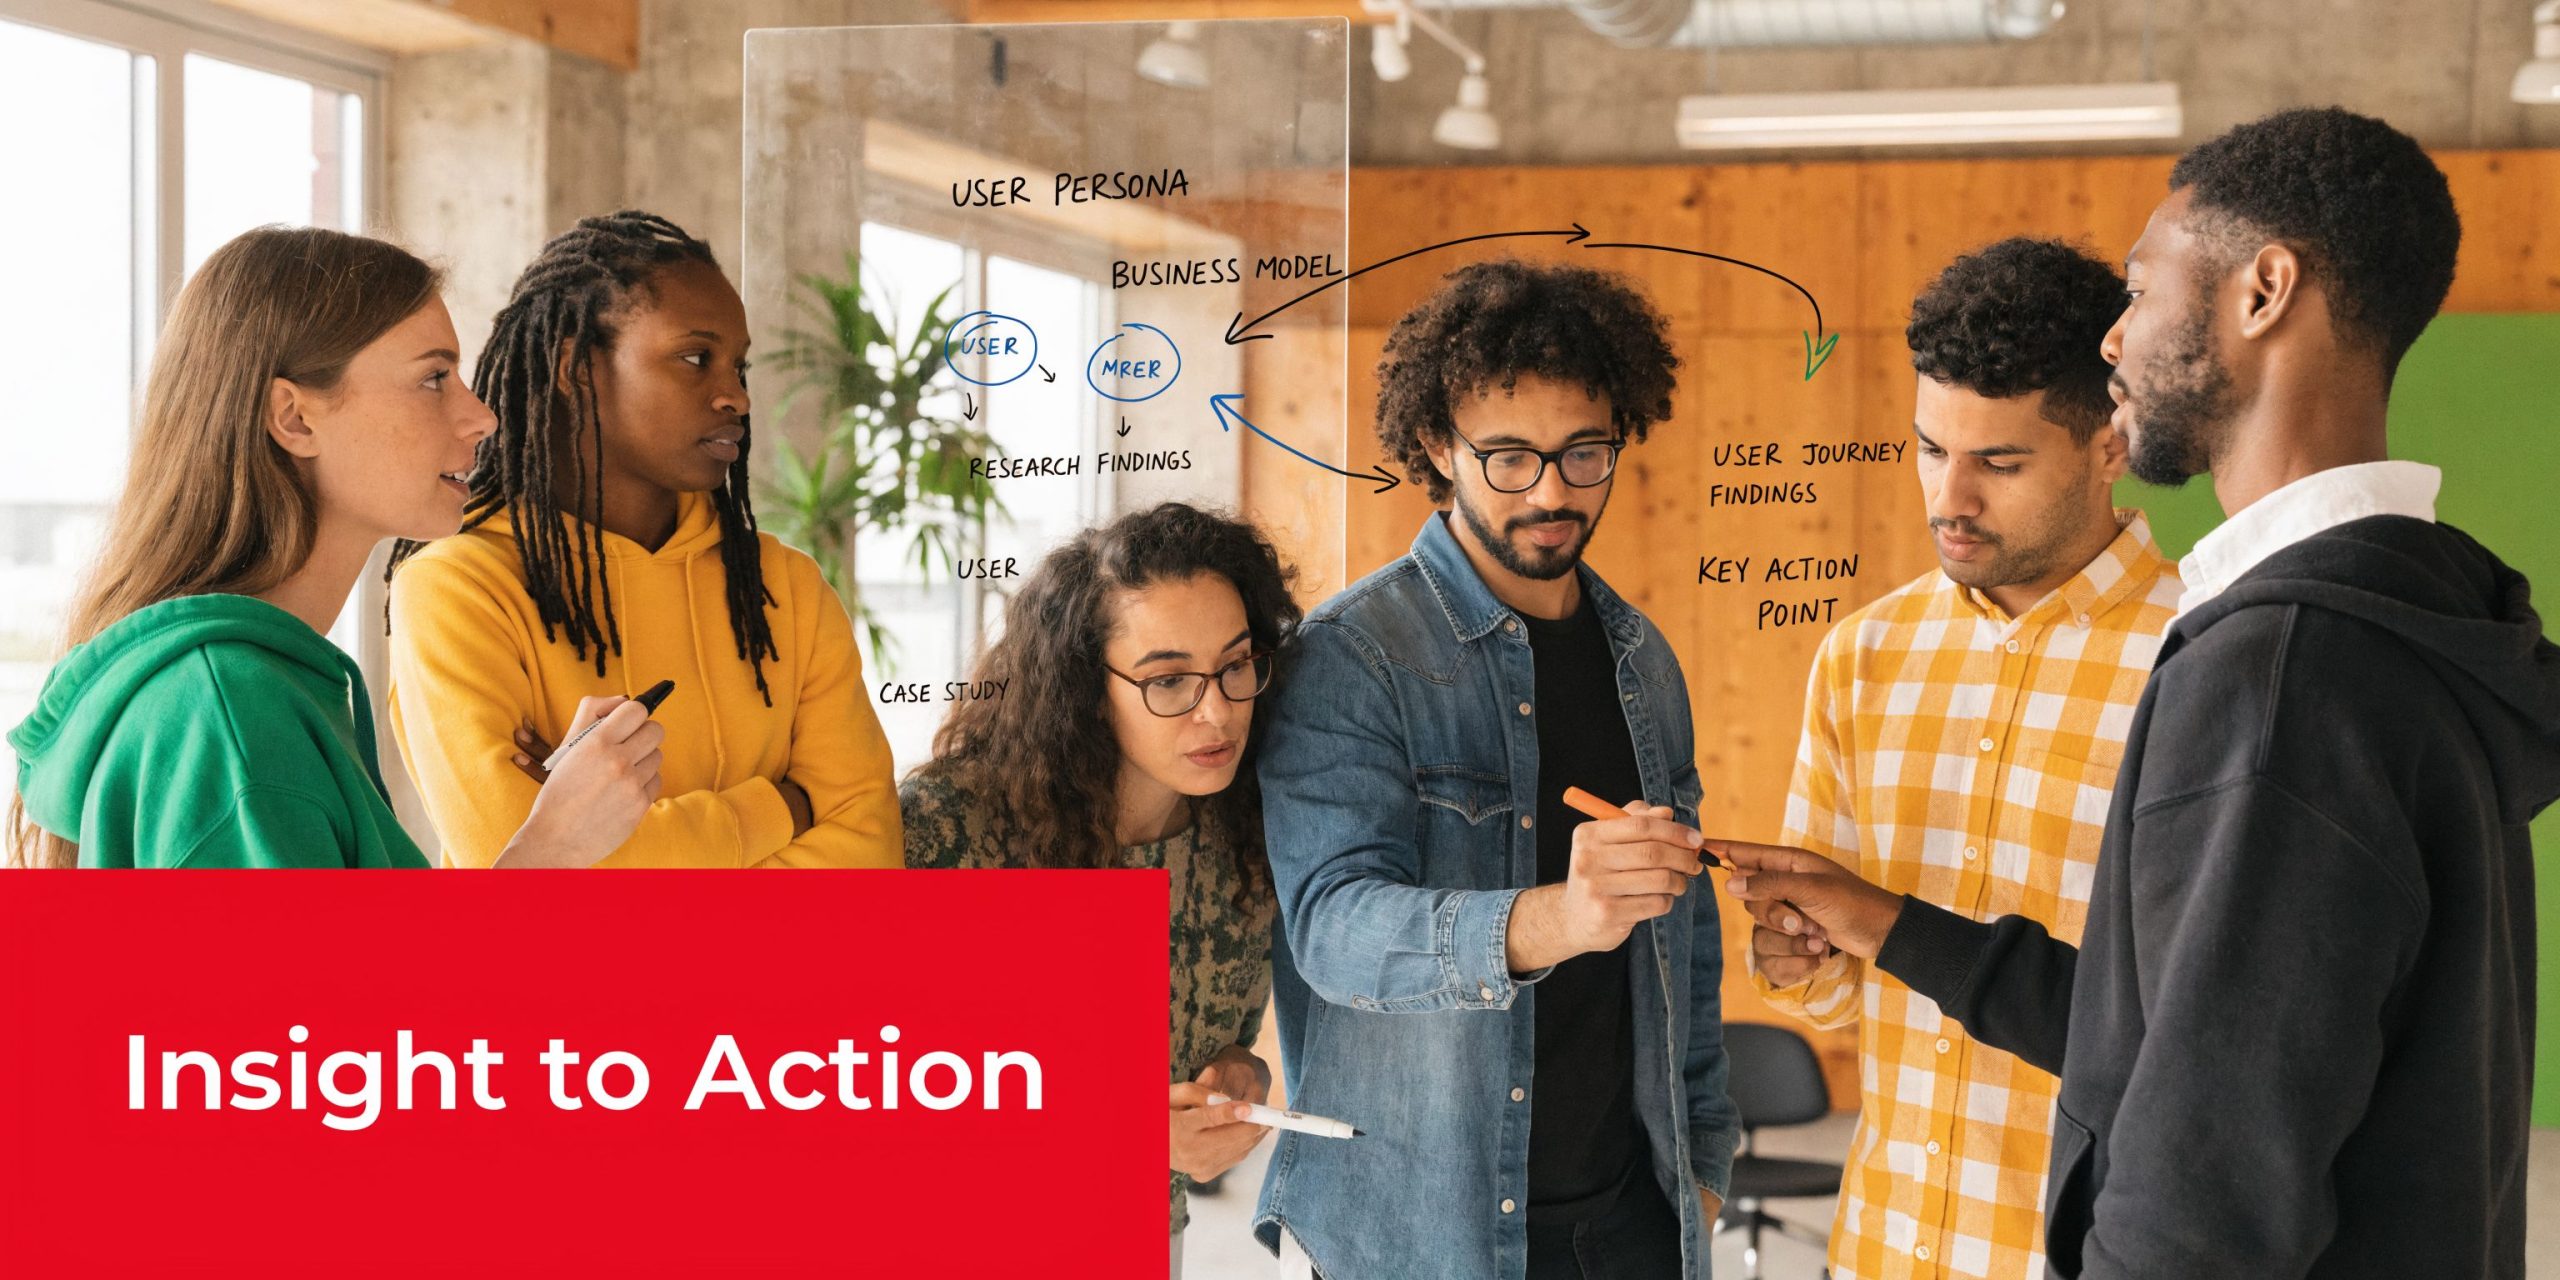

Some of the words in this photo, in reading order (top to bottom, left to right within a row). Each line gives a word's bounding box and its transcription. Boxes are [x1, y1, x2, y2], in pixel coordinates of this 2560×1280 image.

[953, 176, 1030, 207] USER
[1055, 169, 1189, 206] PERSONA
[1112, 258, 1240, 289] BUSINESS
[1256, 254, 1343, 281] MODEL
[961, 337, 1019, 356] USER
[1102, 359, 1162, 379] MRER
[969, 455, 1080, 480] RESEARCH
[1097, 450, 1192, 474] FINDINGS
[1714, 442, 1782, 467] USER
[1802, 440, 1907, 465] JOURNEY
[1711, 482, 1817, 507] FINDINGS
[958, 557, 1019, 579] USER
[1698, 556, 1750, 584] KEY
[1765, 554, 1859, 582] ACTION
[1758, 598, 1838, 630] POINT
[879, 682, 930, 703] CASE
[944, 677, 1009, 701] STUDY
